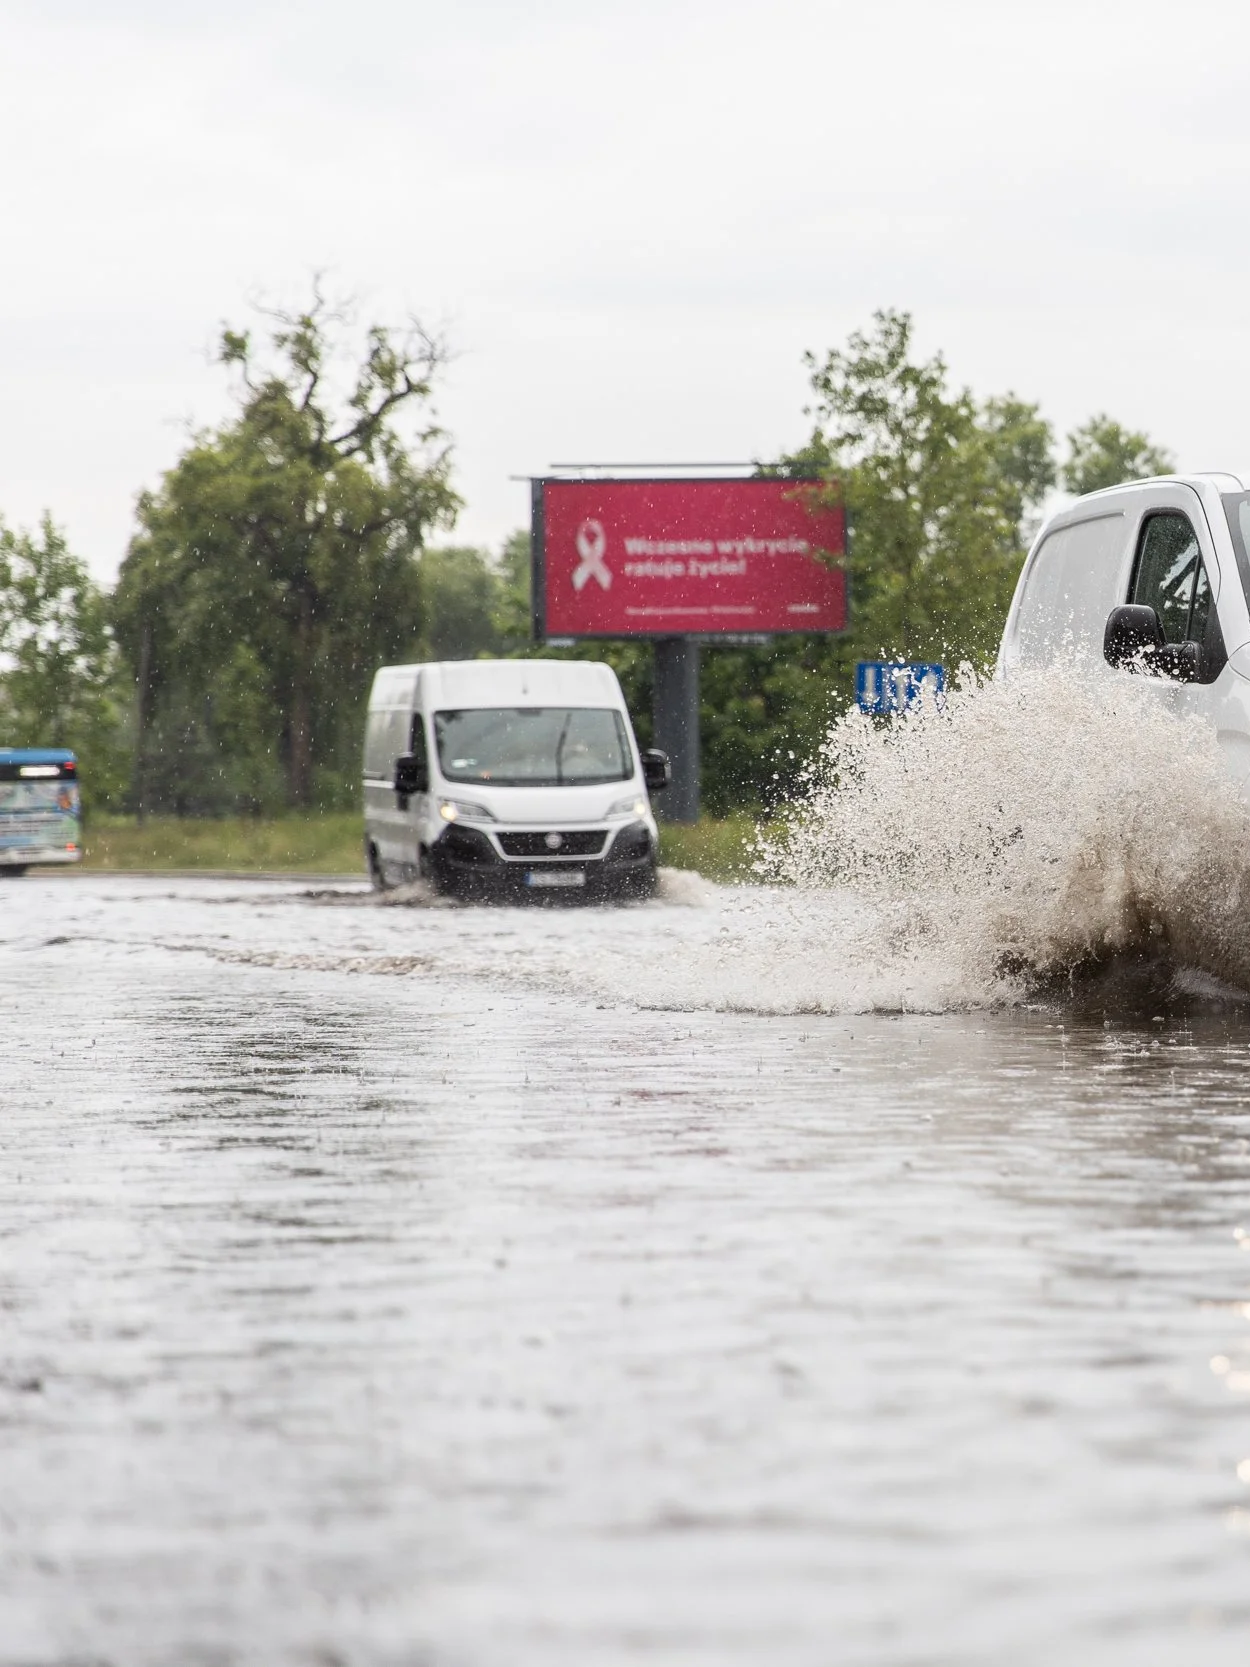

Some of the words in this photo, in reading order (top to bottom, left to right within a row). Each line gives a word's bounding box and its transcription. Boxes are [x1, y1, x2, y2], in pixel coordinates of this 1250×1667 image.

[624, 538, 714, 555] Wczesne
[716, 537, 808, 557] wykrycie
[624, 559, 686, 579] ratuje
